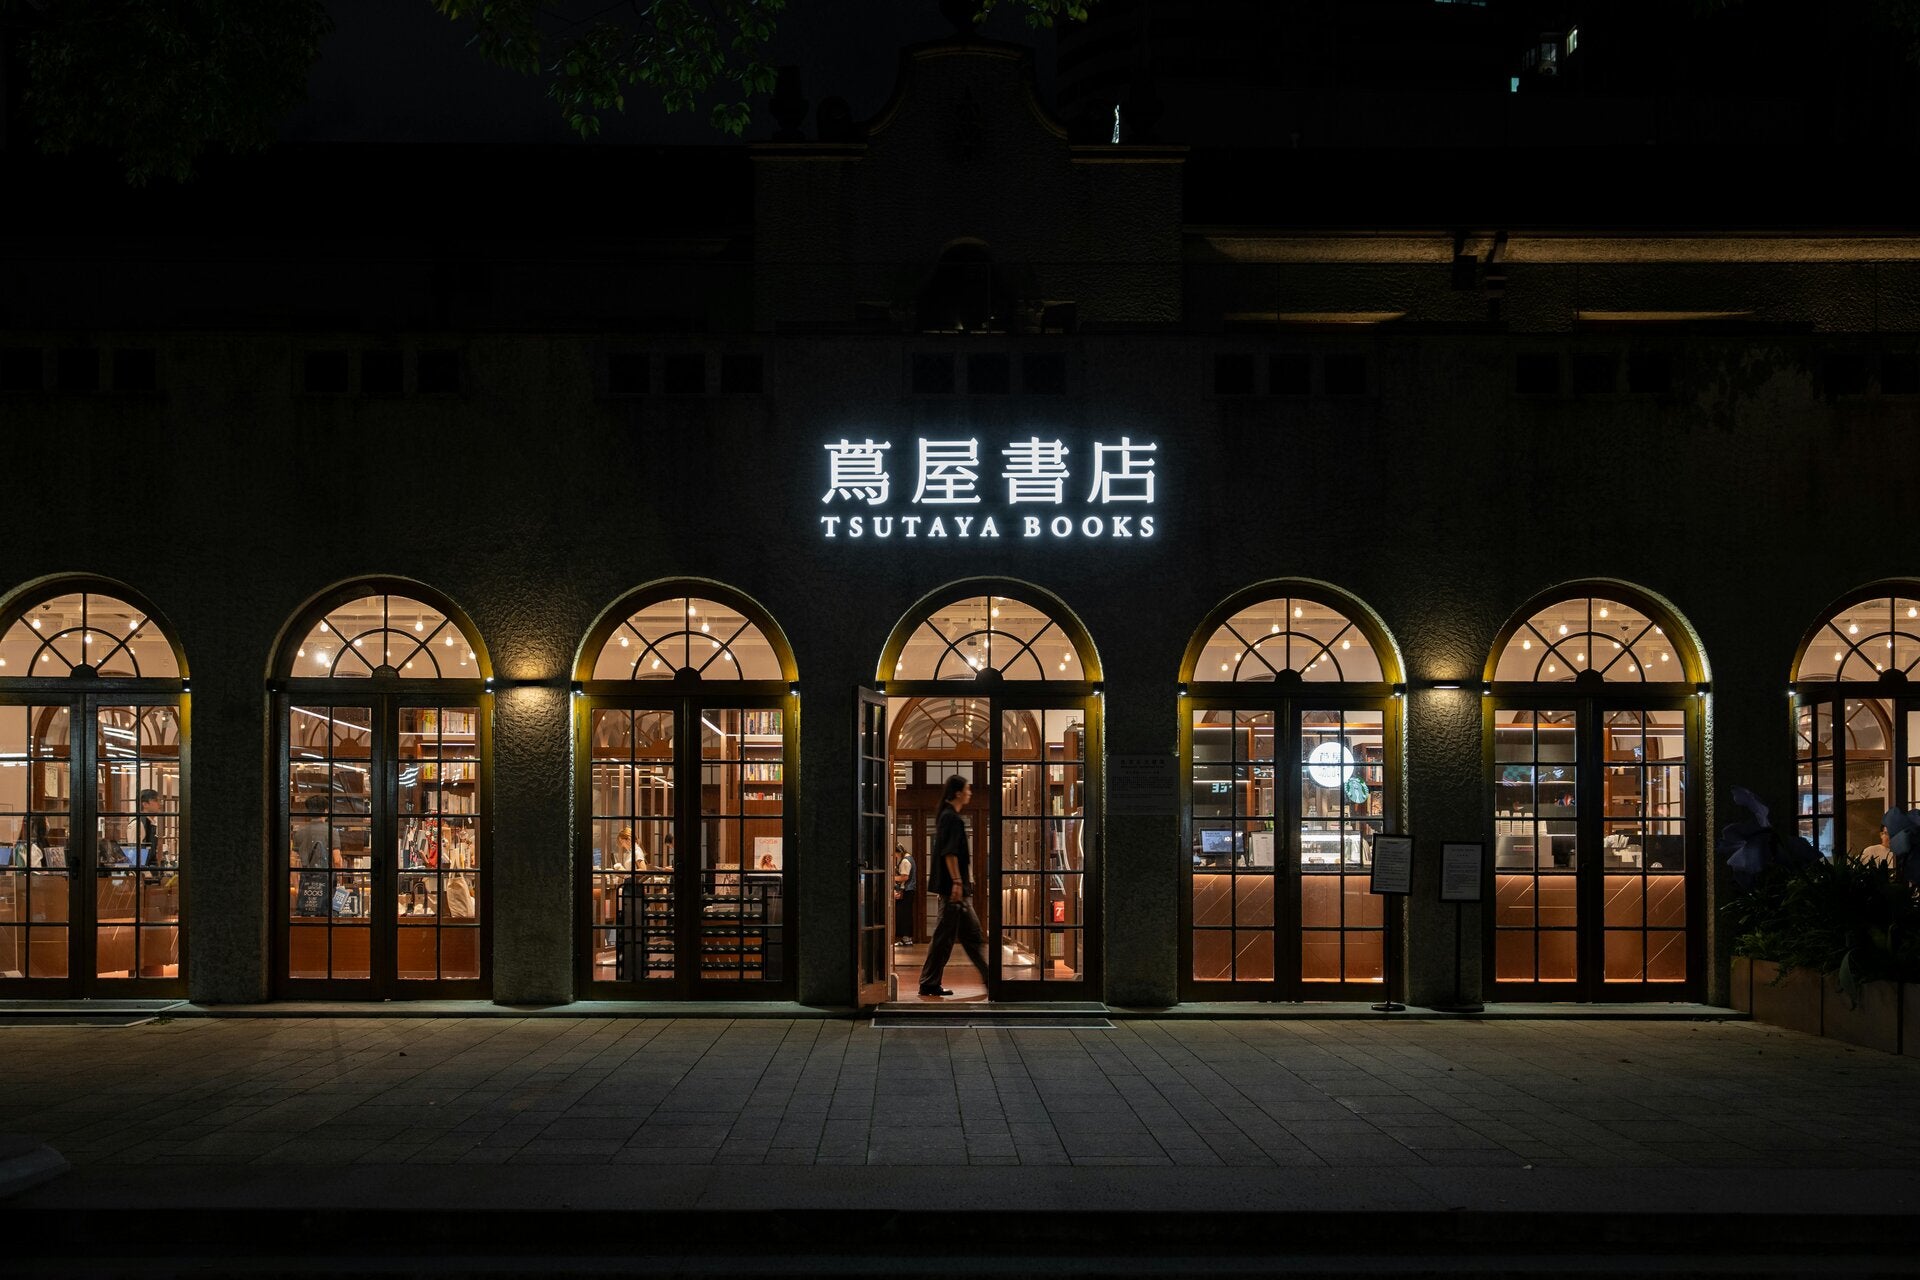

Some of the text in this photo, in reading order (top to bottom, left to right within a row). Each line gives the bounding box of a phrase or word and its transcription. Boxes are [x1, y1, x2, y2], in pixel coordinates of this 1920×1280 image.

[822, 437, 1157, 505] 蔦屋書店
[821, 516, 1154, 537] TSUTAYA BOOKS
